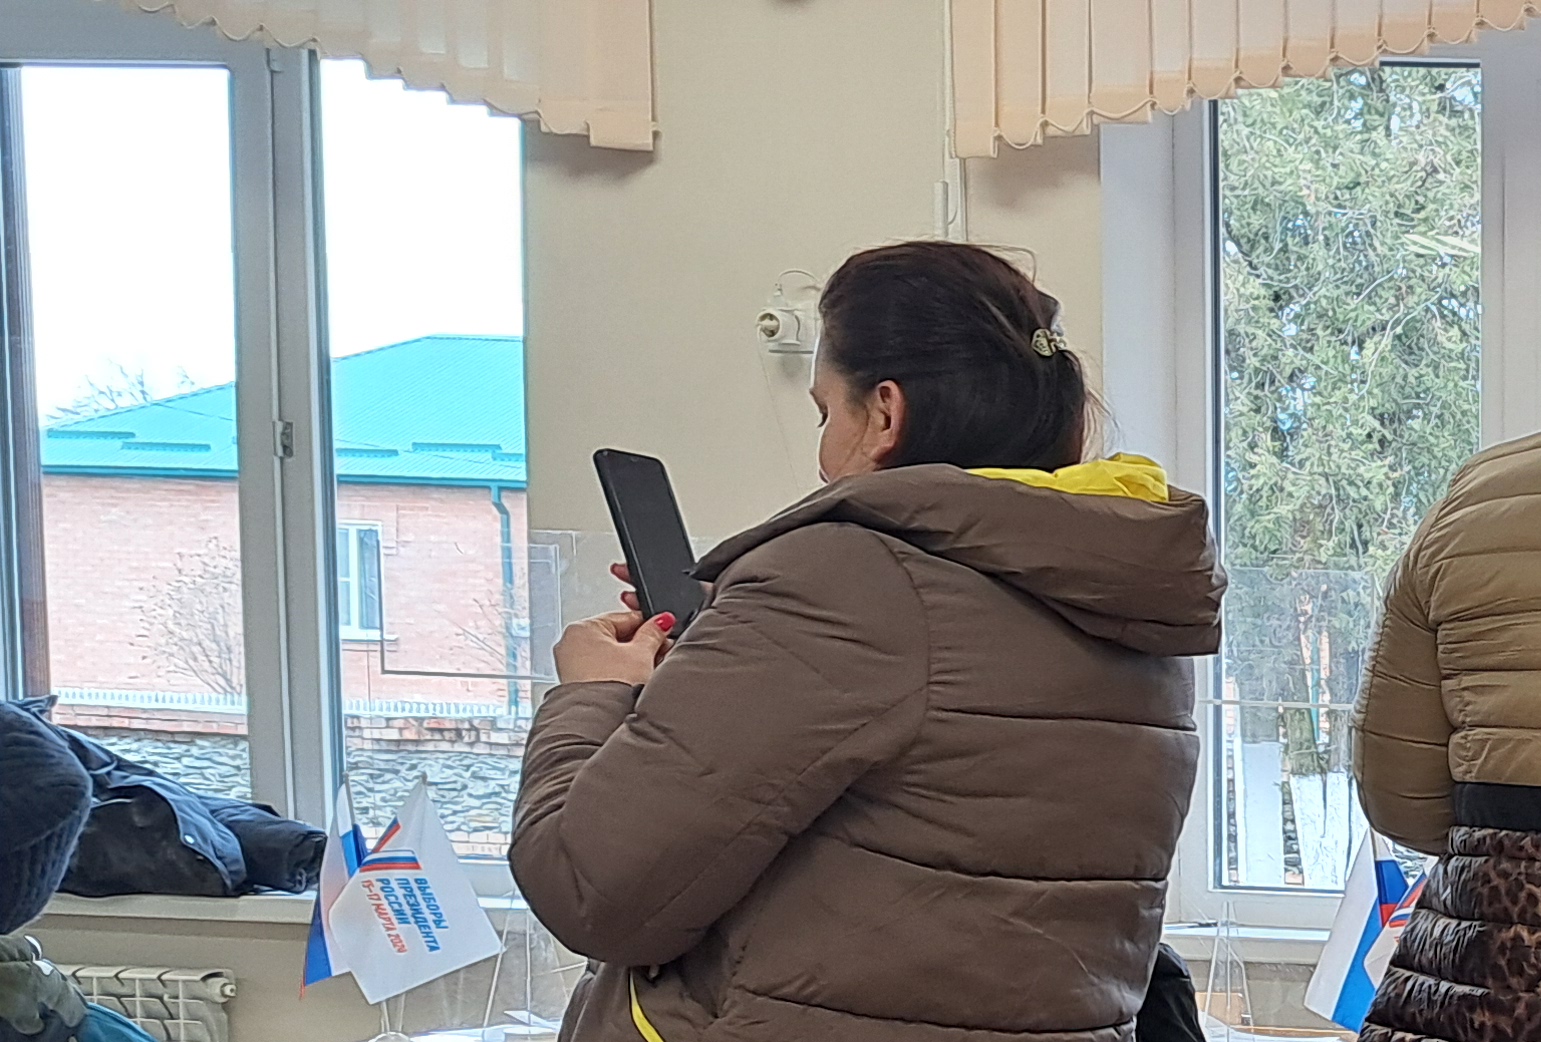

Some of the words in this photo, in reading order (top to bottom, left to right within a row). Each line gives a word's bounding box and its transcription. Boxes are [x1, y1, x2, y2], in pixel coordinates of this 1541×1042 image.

[376, 878, 411, 927] РОССИИ
[395, 878, 441, 952] ПРЕЗИДЕНТА
[414, 878, 449, 930] ВЫБОРЫ
